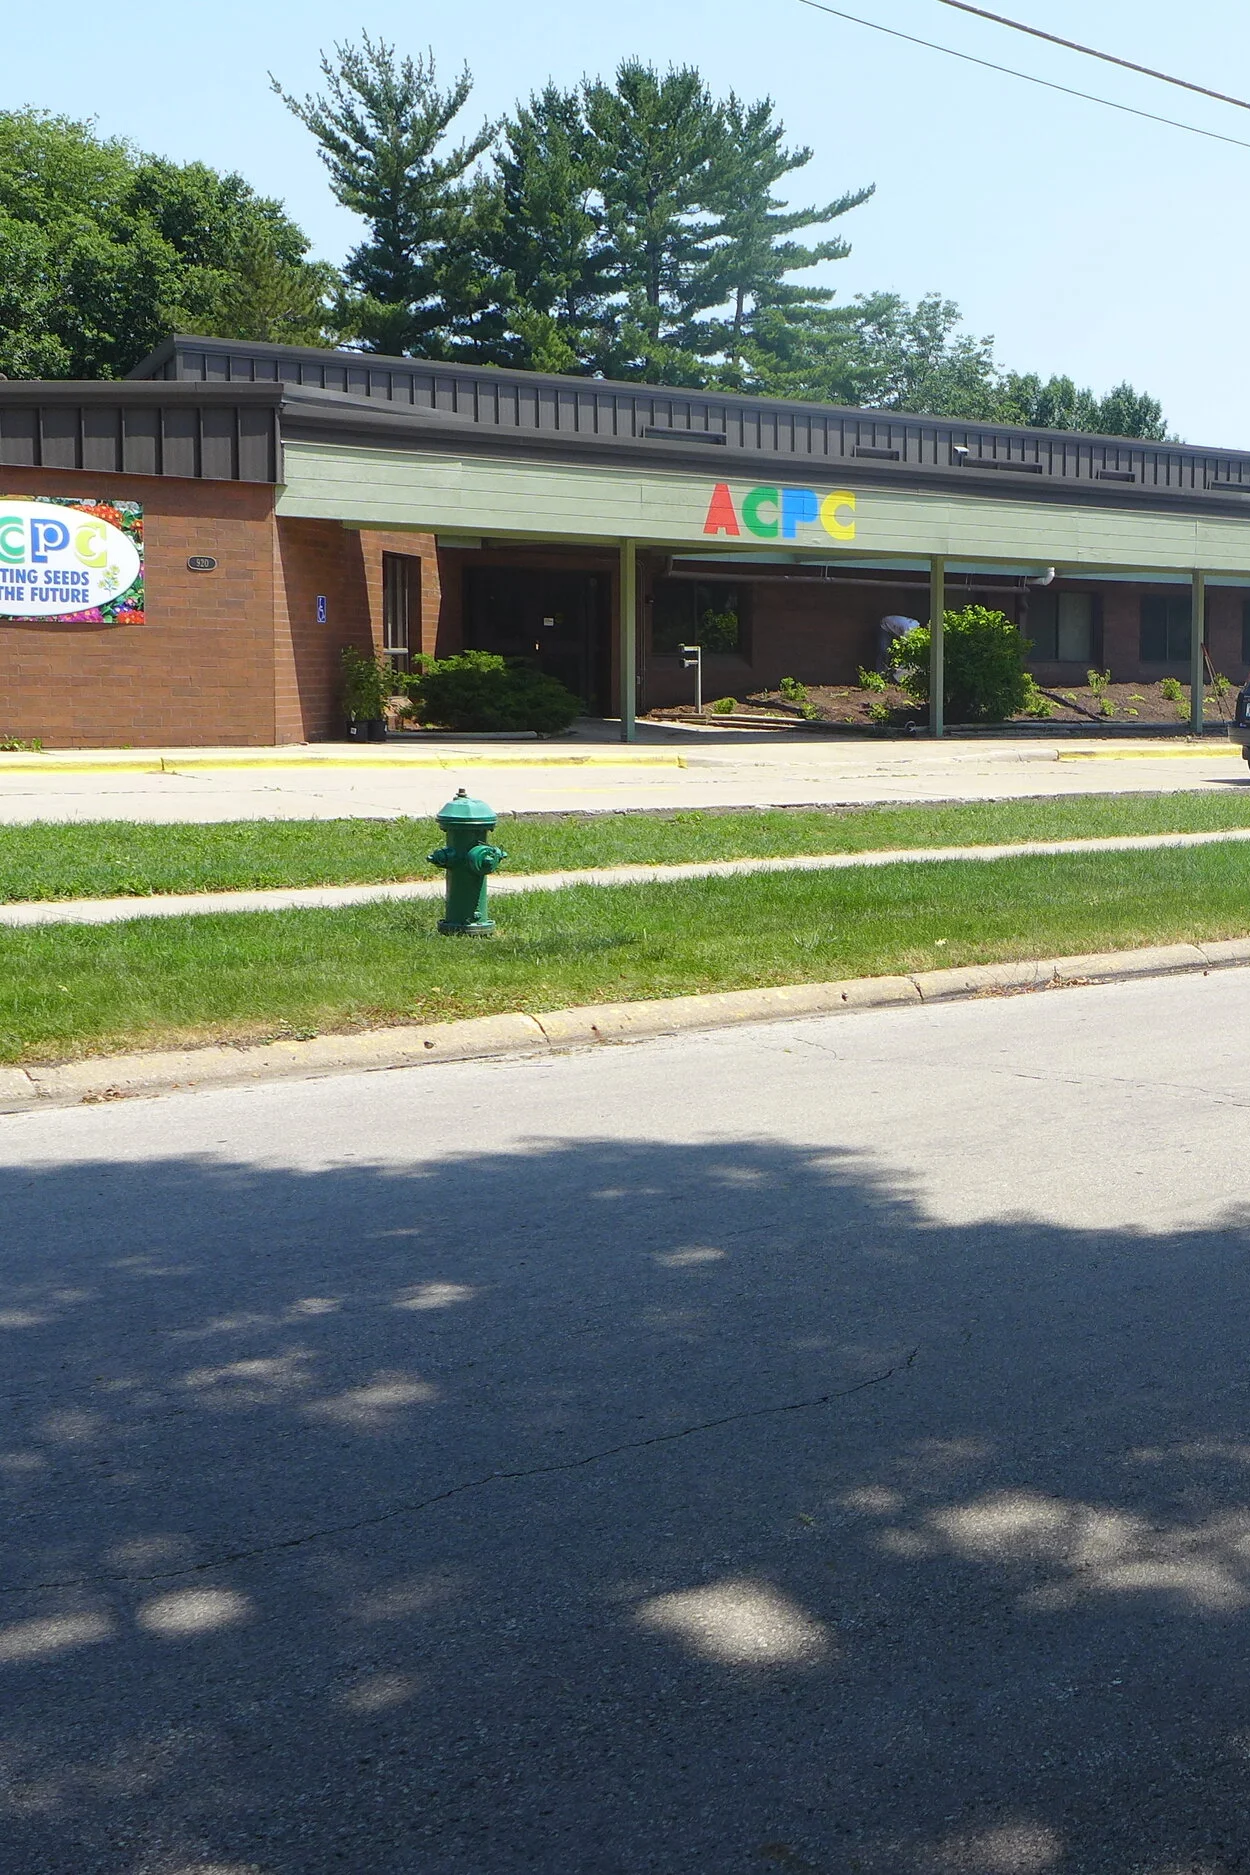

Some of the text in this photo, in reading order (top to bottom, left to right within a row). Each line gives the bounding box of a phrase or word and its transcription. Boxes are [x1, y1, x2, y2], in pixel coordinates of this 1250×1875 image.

[703, 483, 856, 541] ACPC
[196, 558, 209, 568] 920
[0, 568, 90, 586] TING SEEDS
[30, 586, 89, 603] FUTURE
